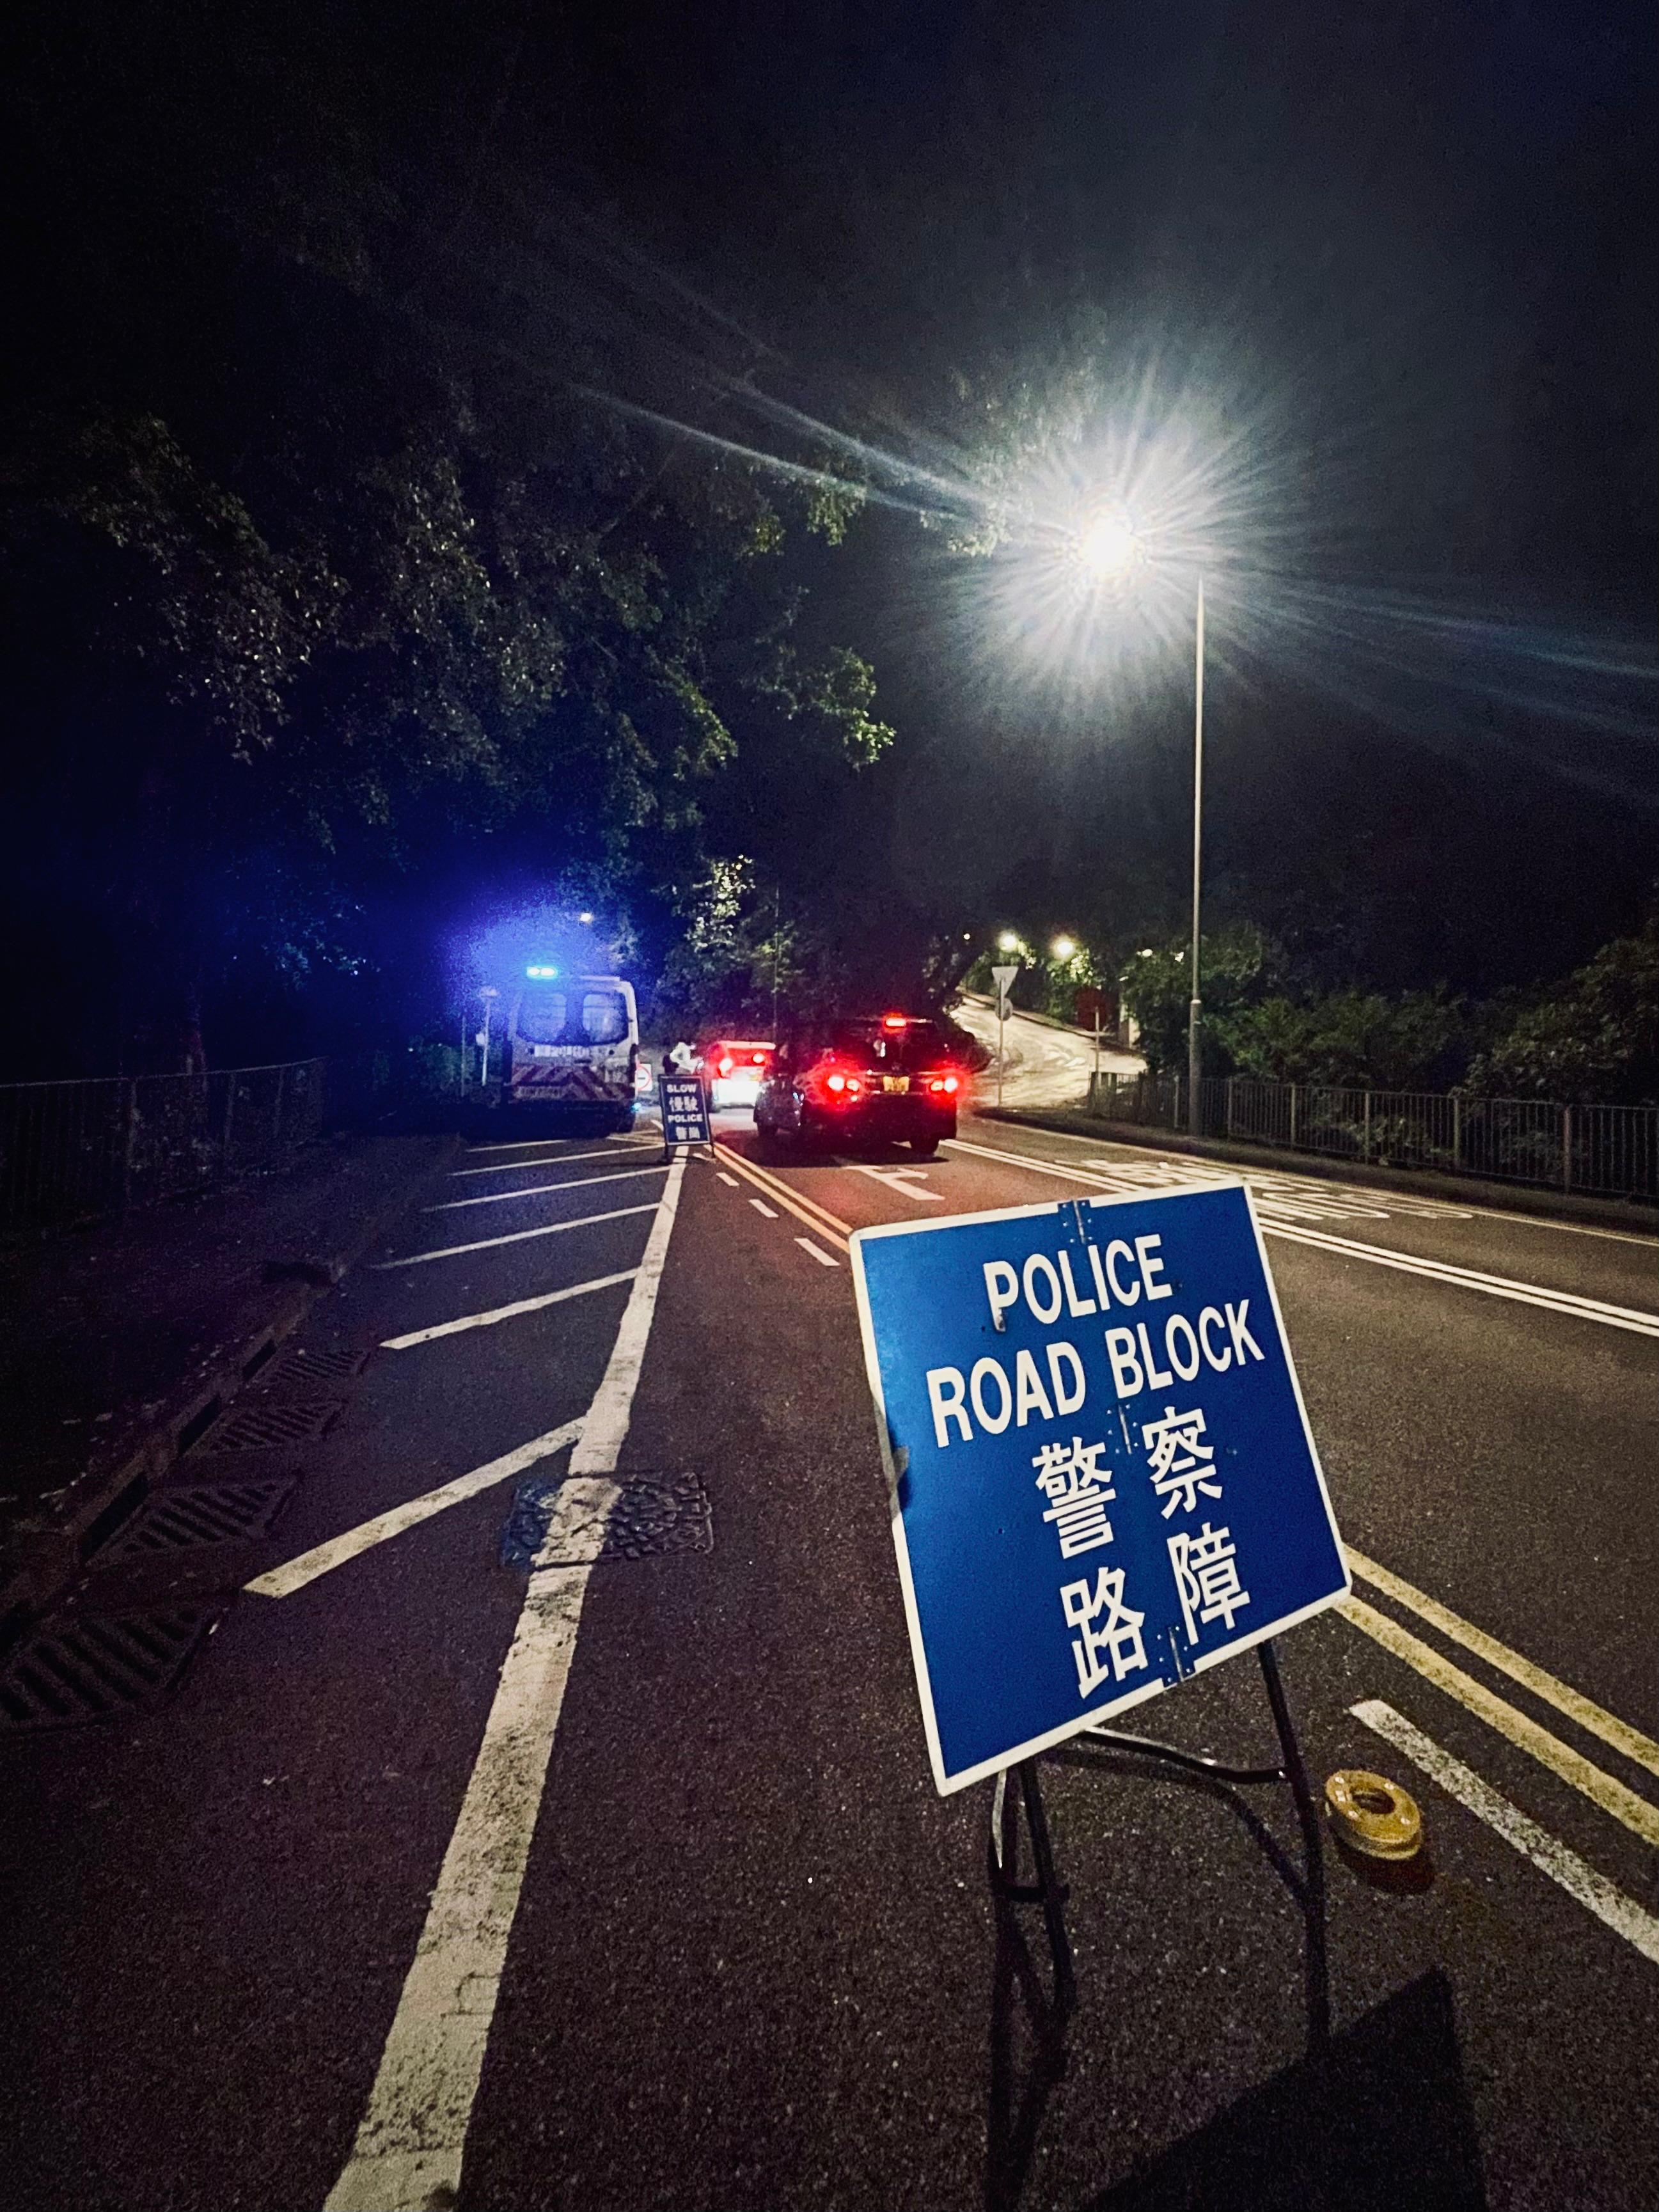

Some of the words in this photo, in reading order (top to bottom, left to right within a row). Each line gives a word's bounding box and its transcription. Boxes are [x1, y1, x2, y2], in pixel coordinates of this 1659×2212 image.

[666, 1084, 697, 1093] SLOW
[668, 1113, 703, 1124] POLICE
[669, 1096, 698, 1112] 慢駛
[983, 1234, 1172, 1331] POLICE
[926, 1342, 1086, 1448] ROAD
[1105, 1299, 1265, 1399] BLOCK
[1032, 1406, 1223, 1559] 警察
[1060, 1523, 1250, 1699] 路障
